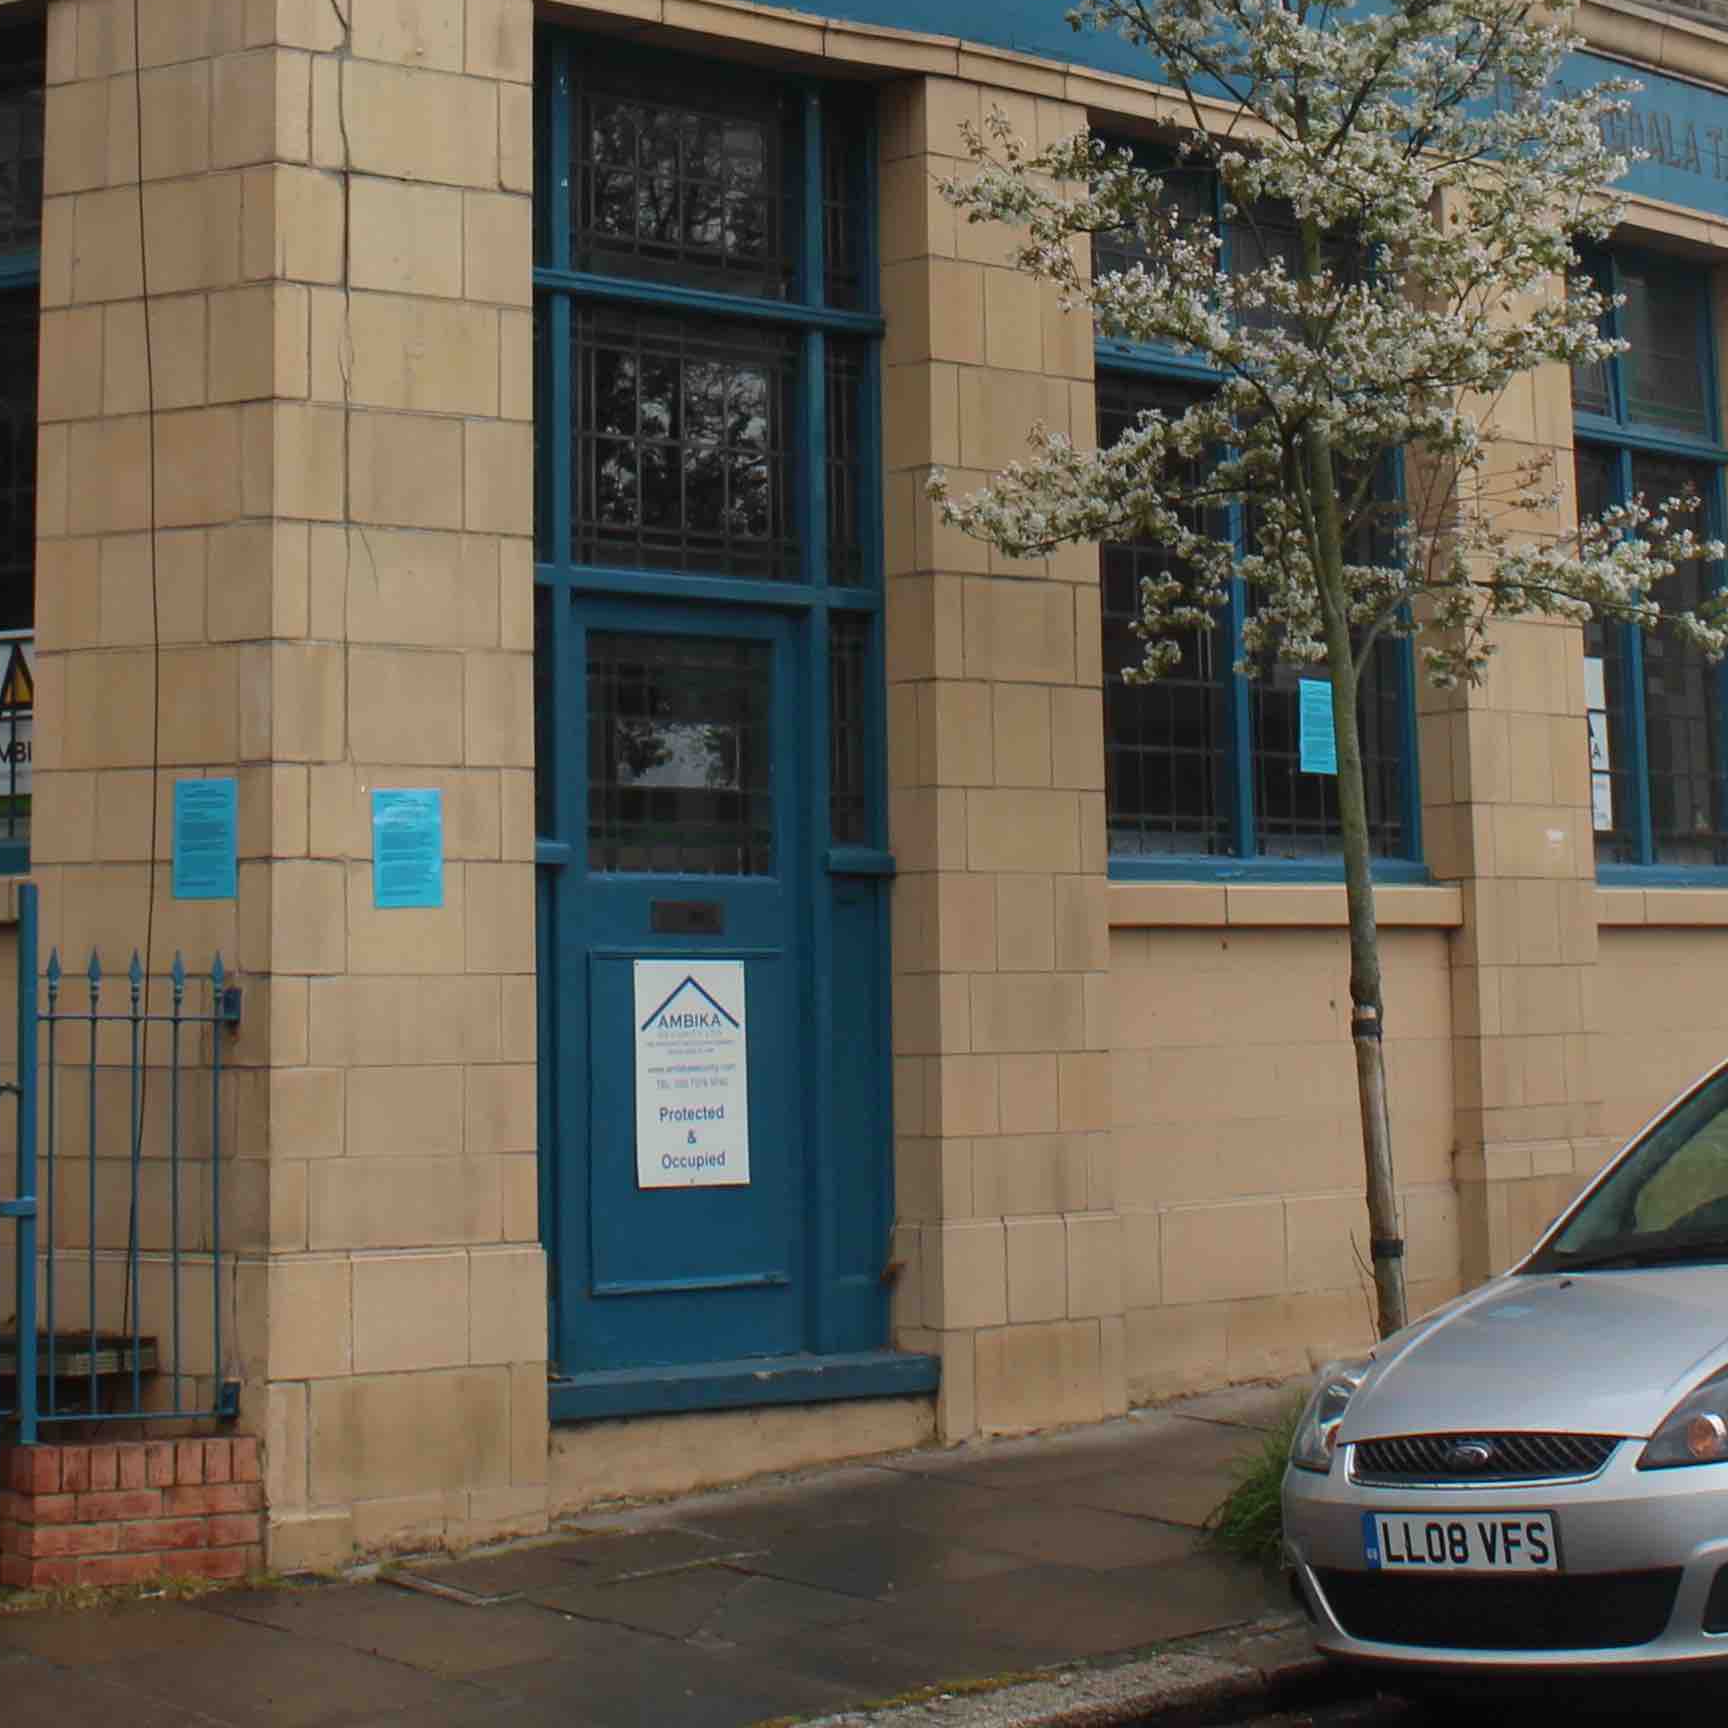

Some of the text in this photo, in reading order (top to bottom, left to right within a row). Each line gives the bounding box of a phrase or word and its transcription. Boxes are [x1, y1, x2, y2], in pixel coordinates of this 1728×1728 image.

[656, 1012, 721, 1030] AMBIKA
[659, 1104, 725, 1122] Protected
[687, 1130, 697, 1145] &
[661, 1150, 726, 1171] Occupied
[1381, 1521, 1550, 1564] LL08 VFS
